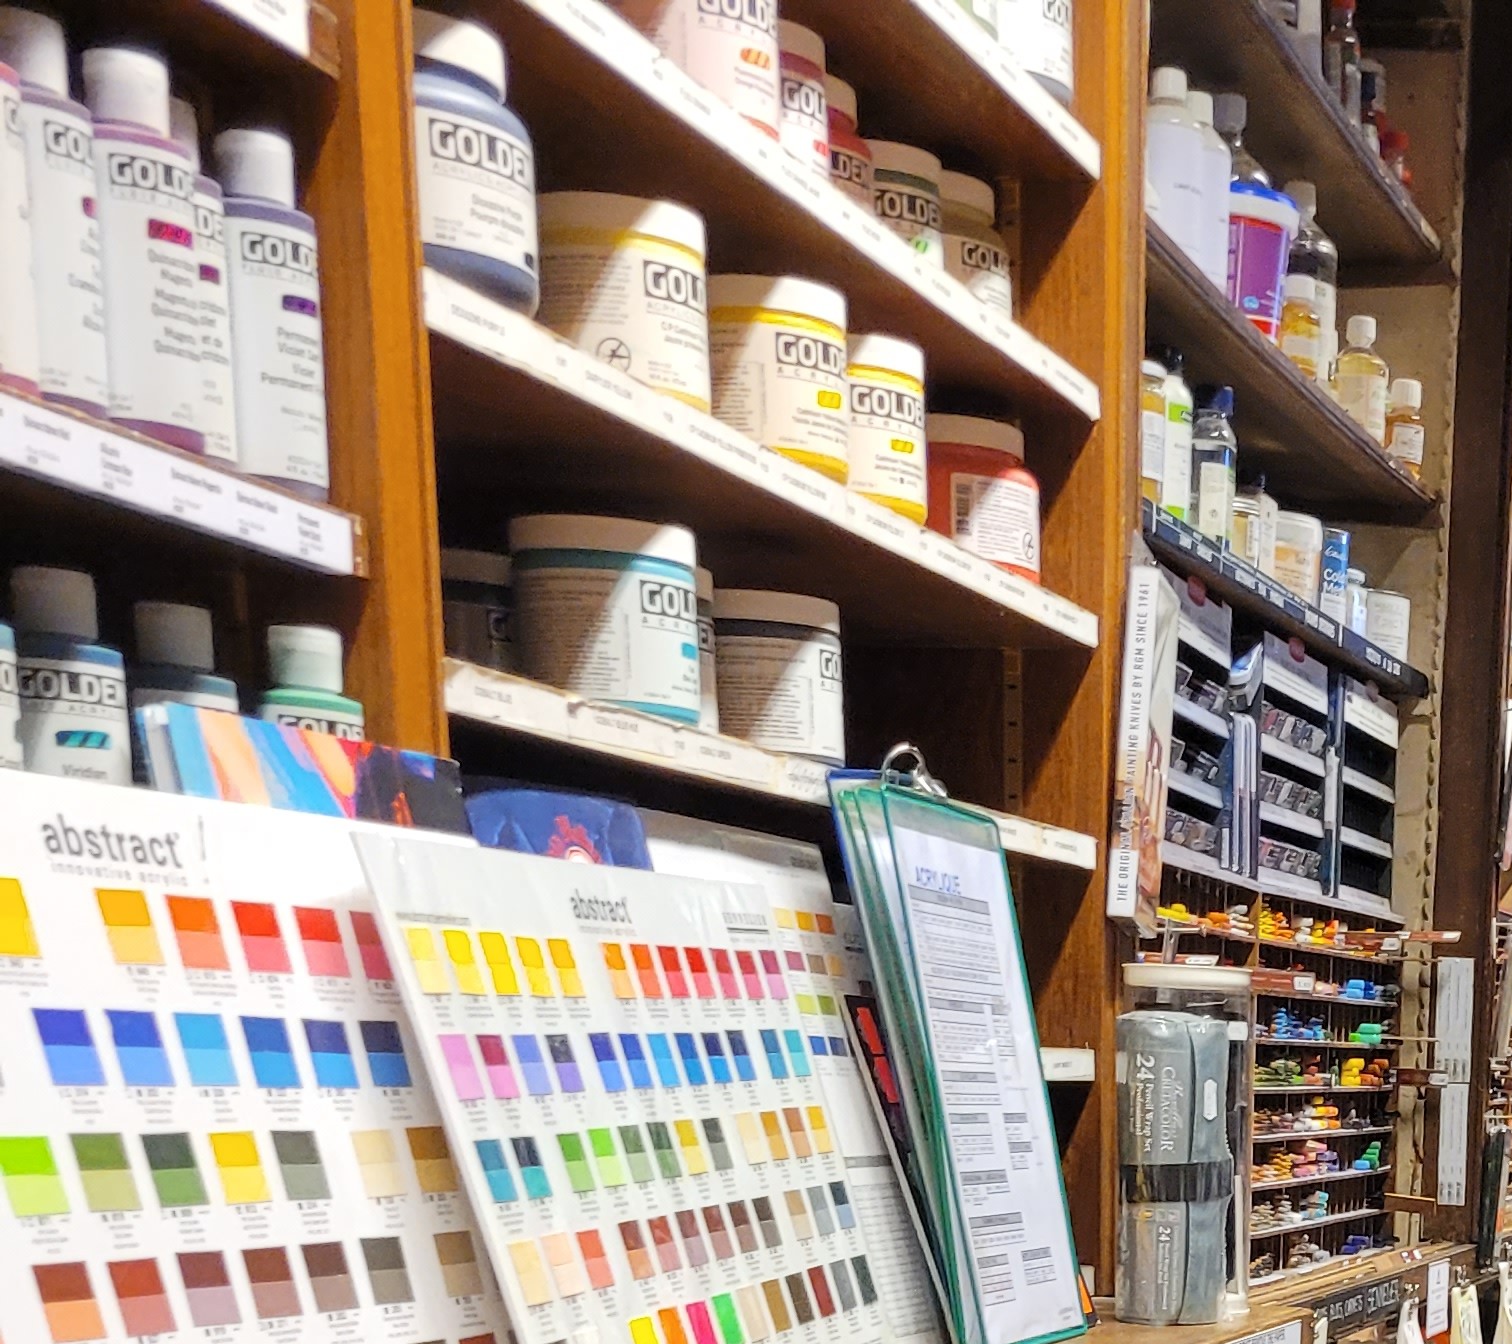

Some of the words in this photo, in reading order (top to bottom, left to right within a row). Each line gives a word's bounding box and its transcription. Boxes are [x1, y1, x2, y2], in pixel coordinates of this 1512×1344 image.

[109, 154, 194, 197] GOLD
[241, 232, 317, 275] GOLD
[776, 333, 846, 380] GOLD
[851, 385, 924, 427] GOLDE
[1138, 583, 1150, 607] 1961
[1135, 611, 1147, 643] SINCE
[1133, 648, 1145, 670] RGM
[18, 670, 123, 706] GOLDE
[1132, 675, 1143, 687] BY
[1129, 692, 1142, 731] KNIVES
[42, 813, 183, 868] abstract
[570, 888, 632, 924] abstract
[1117, 883, 1128, 901] THE
[1136, 1053, 1155, 1081] 24
[1157, 1225, 1171, 1242] 24
